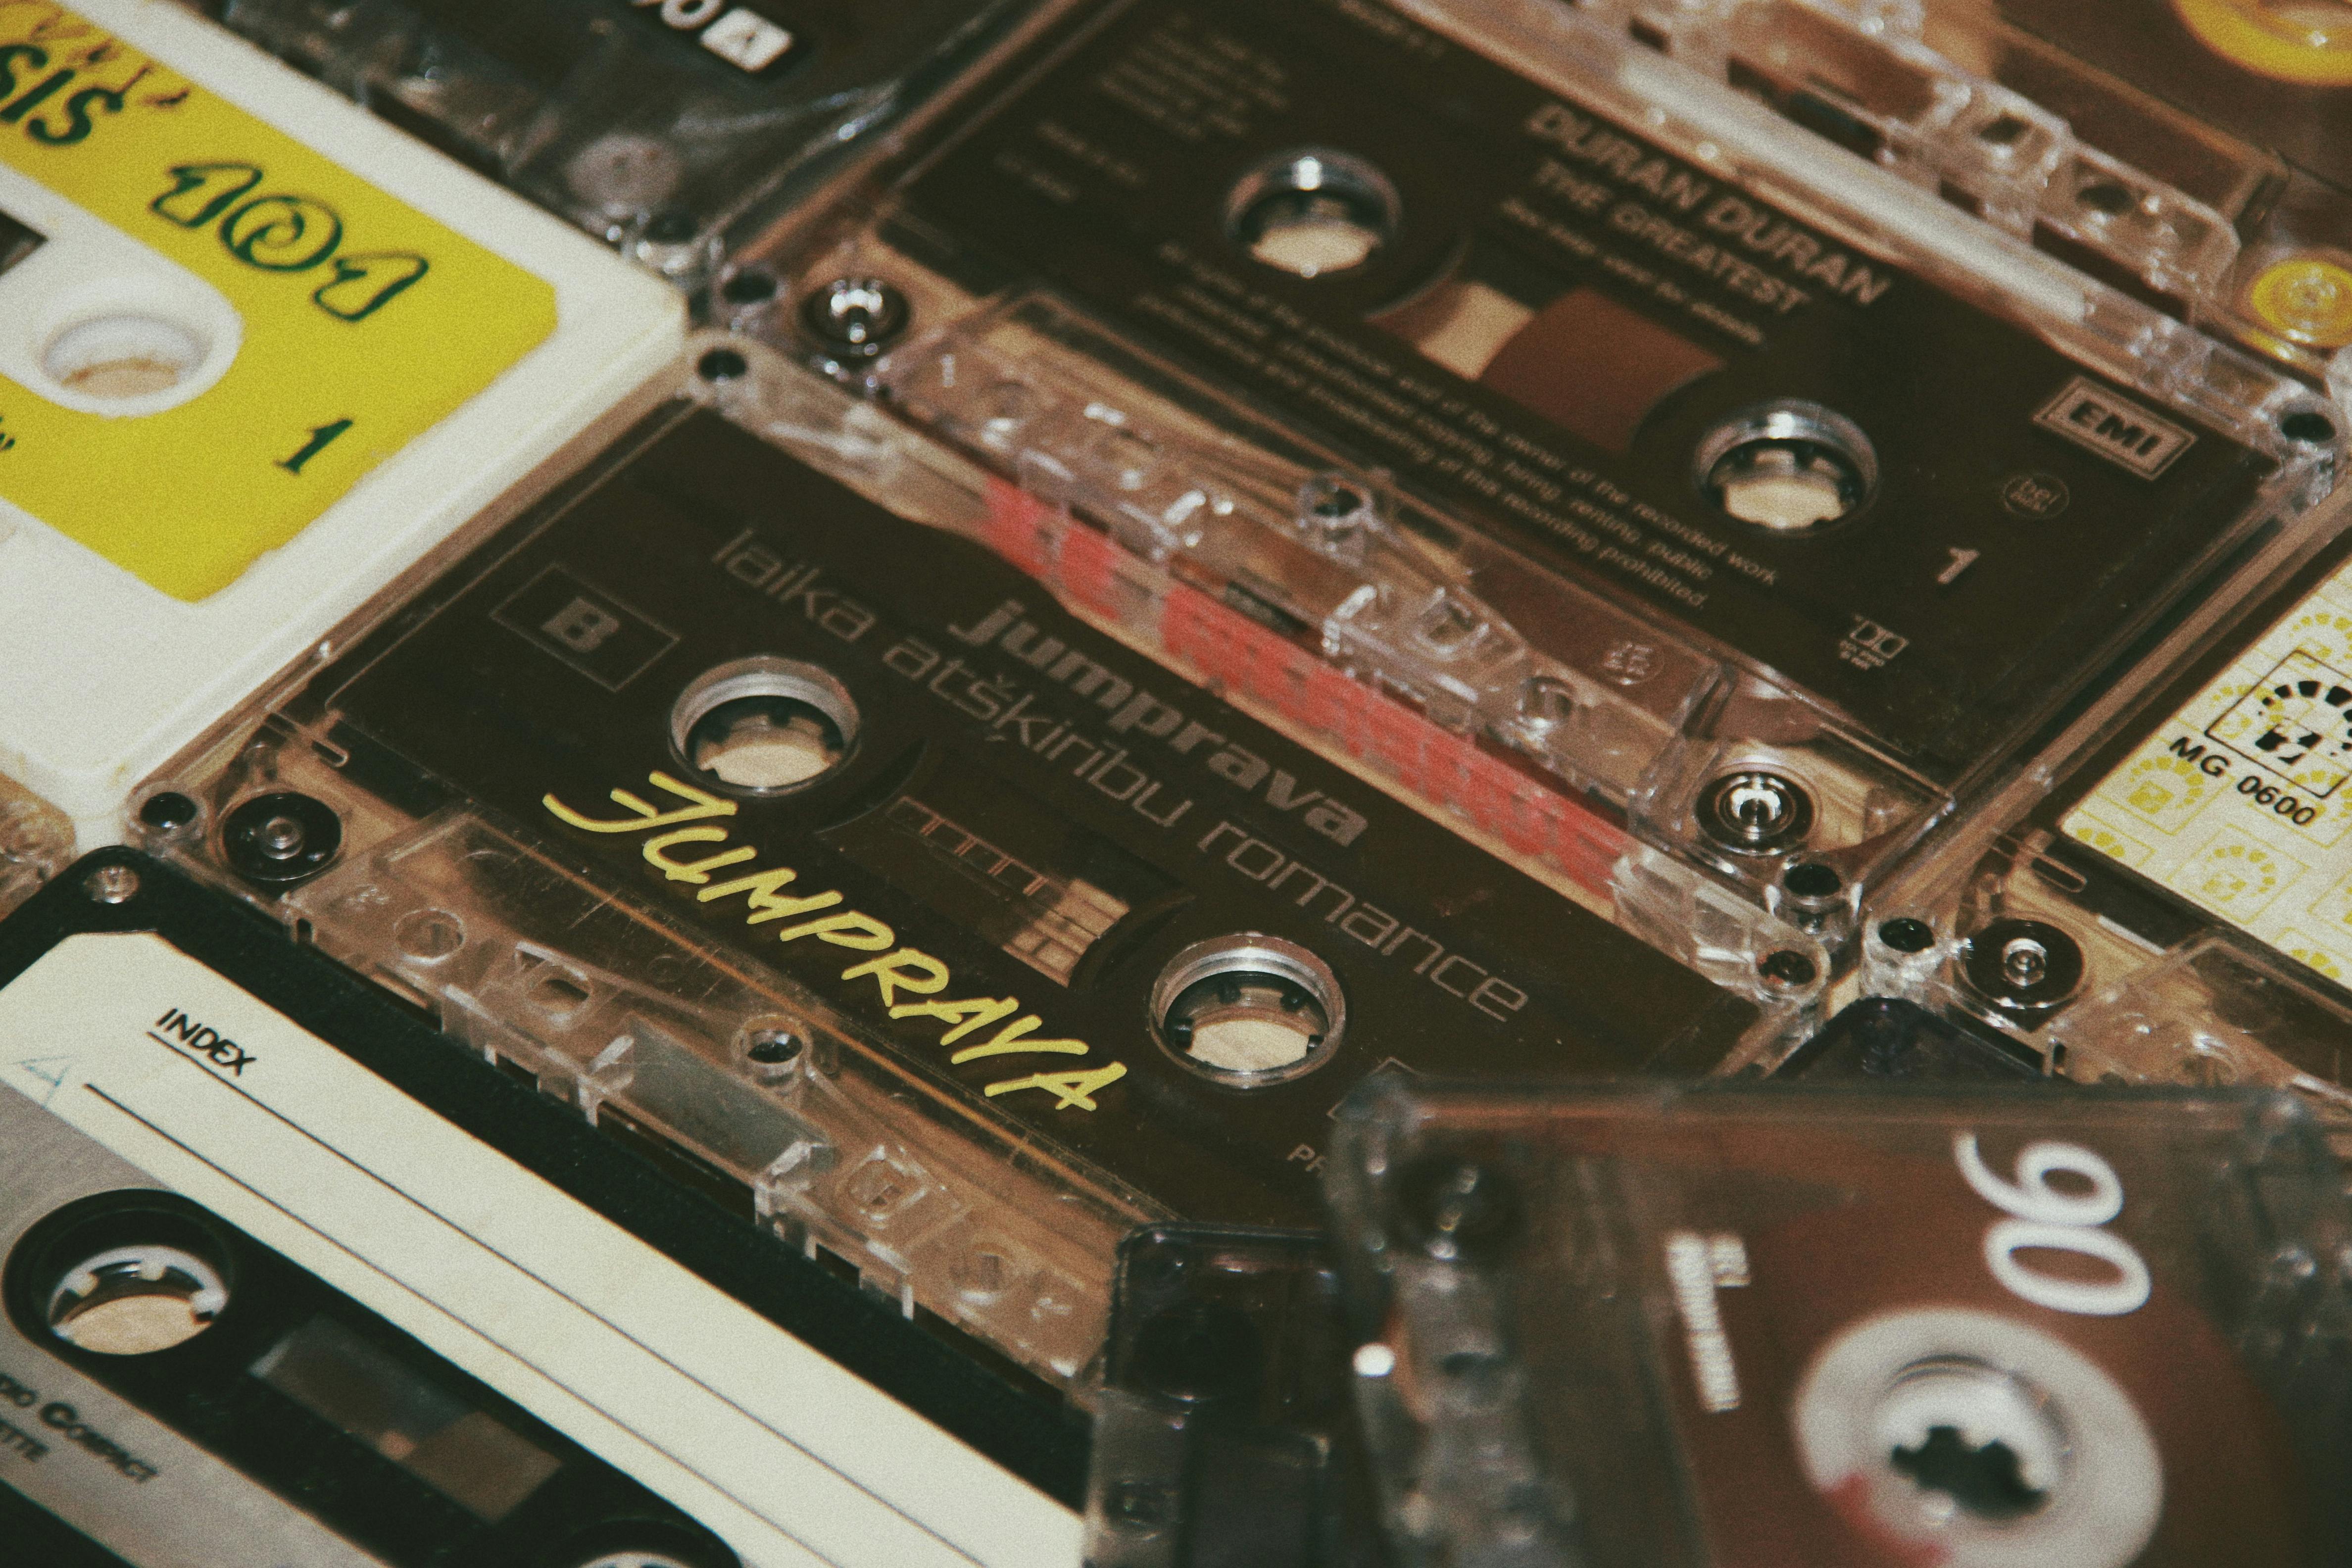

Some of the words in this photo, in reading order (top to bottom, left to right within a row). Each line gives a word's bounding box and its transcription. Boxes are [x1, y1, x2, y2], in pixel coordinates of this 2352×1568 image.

[149, 162, 430, 323] 101
[1526, 103, 1712, 211] DURAN
[1702, 198, 1892, 306] DURAN
[1534, 159, 1614, 213] THE
[1610, 201, 1812, 315] GREATEST
[275, 418, 354, 475] 1
[2068, 401, 2164, 457] EMI
[1631, 499, 1729, 558] recorded
[1726, 551, 1780, 585] work
[1646, 539, 1715, 581] public
[1936, 546, 1980, 584] 1
[539, 596, 621, 653] B
[947, 598, 1369, 846] jumprava
[711, 527, 876, 643] laika
[1196, 821, 1529, 1023] romance
[2169, 736, 2232, 778] MG
[2237, 775, 2317, 827] 0600
[155, 1008, 257, 1077] INDEX
[1953, 1128, 2153, 1316] 90
